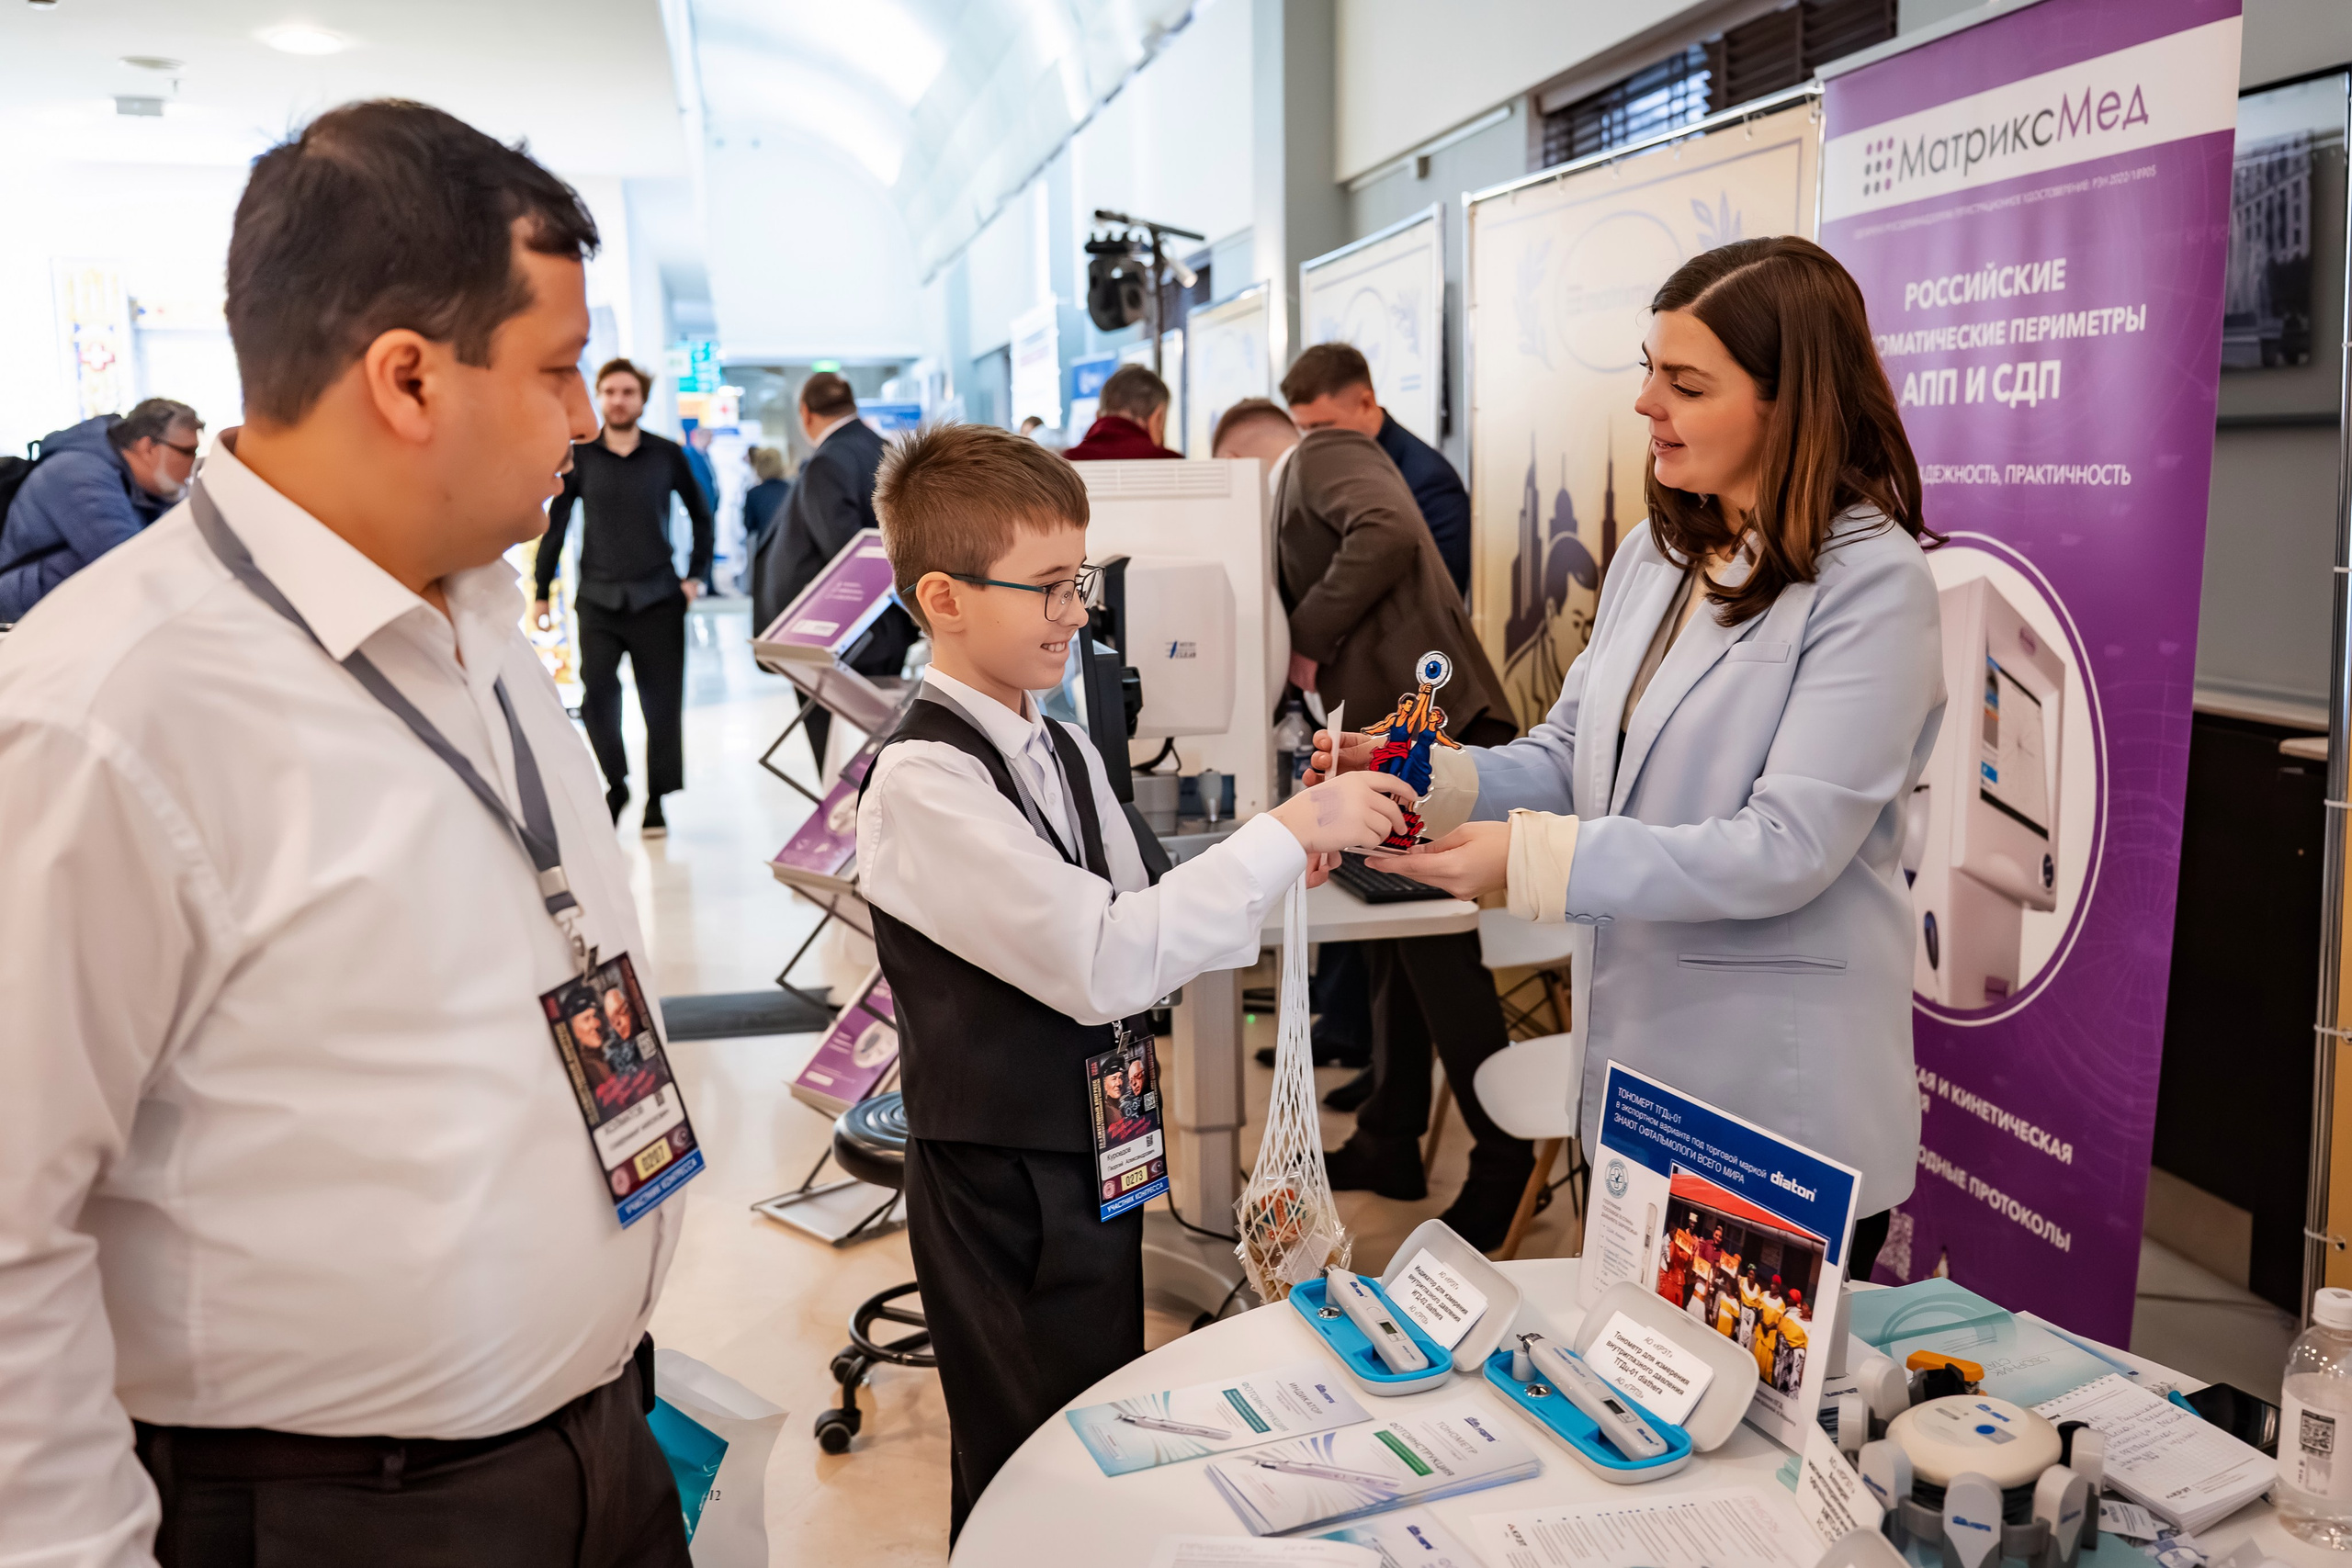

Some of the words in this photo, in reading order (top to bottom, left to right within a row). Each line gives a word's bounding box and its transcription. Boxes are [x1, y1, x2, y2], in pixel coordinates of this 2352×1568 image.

[1898, 84, 2149, 183] МатриксМед
[1905, 257, 2067, 312] РОССИЙСКИЕ
[1876, 321, 2007, 356] ОМАТИЧЕСКИЕ
[2009, 303, 2147, 344] ПЕРИМЕТРЫ
[1901, 367, 1959, 407] АПП
[1964, 366, 1986, 404] И
[1992, 359, 2062, 409] СДП
[2005, 464, 2132, 486] ПРАКТИЧНОСТЬ
[1618, 1087, 1654, 1111] ТОНОМЕРТ
[1656, 1104, 1681, 1123] ТГДц-01
[1938, 1077, 1950, 1100] И
[1950, 1084, 2074, 1166] КИНЕТИЧЕСКАЯ
[1614, 1112, 1638, 1131] ЗНАЮТ
[1638, 1124, 1697, 1160] ОФТАЛЬМОЛОГИ
[1697, 1153, 1722, 1173] ВСЕГО
[1723, 1166, 1745, 1184] МИРА
[1621, 1104, 1659, 1126] экспортном
[1659, 1122, 1690, 1142] варианте
[1691, 1137, 1704, 1150] под
[1706, 1144, 1738, 1165] торговой
[1739, 1160, 1767, 1179] маркой
[1106, 1193, 1135, 1213] УЧАСТНИК
[1136, 1181, 1163, 1201] КОНГРЕССА
[1125, 1169, 1144, 1187] 0273
[1968, 1176, 2072, 1253] ПРОТОКОЛЫ
[1408, 1274, 1441, 1306] внутриглазного
[1439, 1300, 1462, 1323] давления
[1411, 1289, 1428, 1306] ИГД-02
[1425, 1303, 1443, 1321] diathera
[1414, 1264, 1436, 1288] Индикатор
[1435, 1282, 1445, 1294] для
[1444, 1291, 1469, 1315] измерения
[1613, 1330, 1644, 1355] Тонометр
[1642, 1348, 1655, 1362] для
[1655, 1356, 1690, 1386] измерения
[1644, 1336, 1654, 1346] АО
[1995, 1355, 2051, 1377] СБОРНИК
[1605, 1340, 1654, 1375] внутриглазного
[1652, 1369, 1685, 1396] давления
[1614, 1356, 1639, 1378] ТГДц-01
[1637, 1373, 1664, 1395] diathera
[1241, 1381, 1290, 1432] ФОТОИНСТРУКЦИЯ
[1288, 1381, 1324, 1416] ИНДИКАТОР
[1389, 1422, 1455, 1477] ФОТОИНСТРУКЦИЯ
[1435, 1420, 1478, 1454] ТОНОМЕТР
